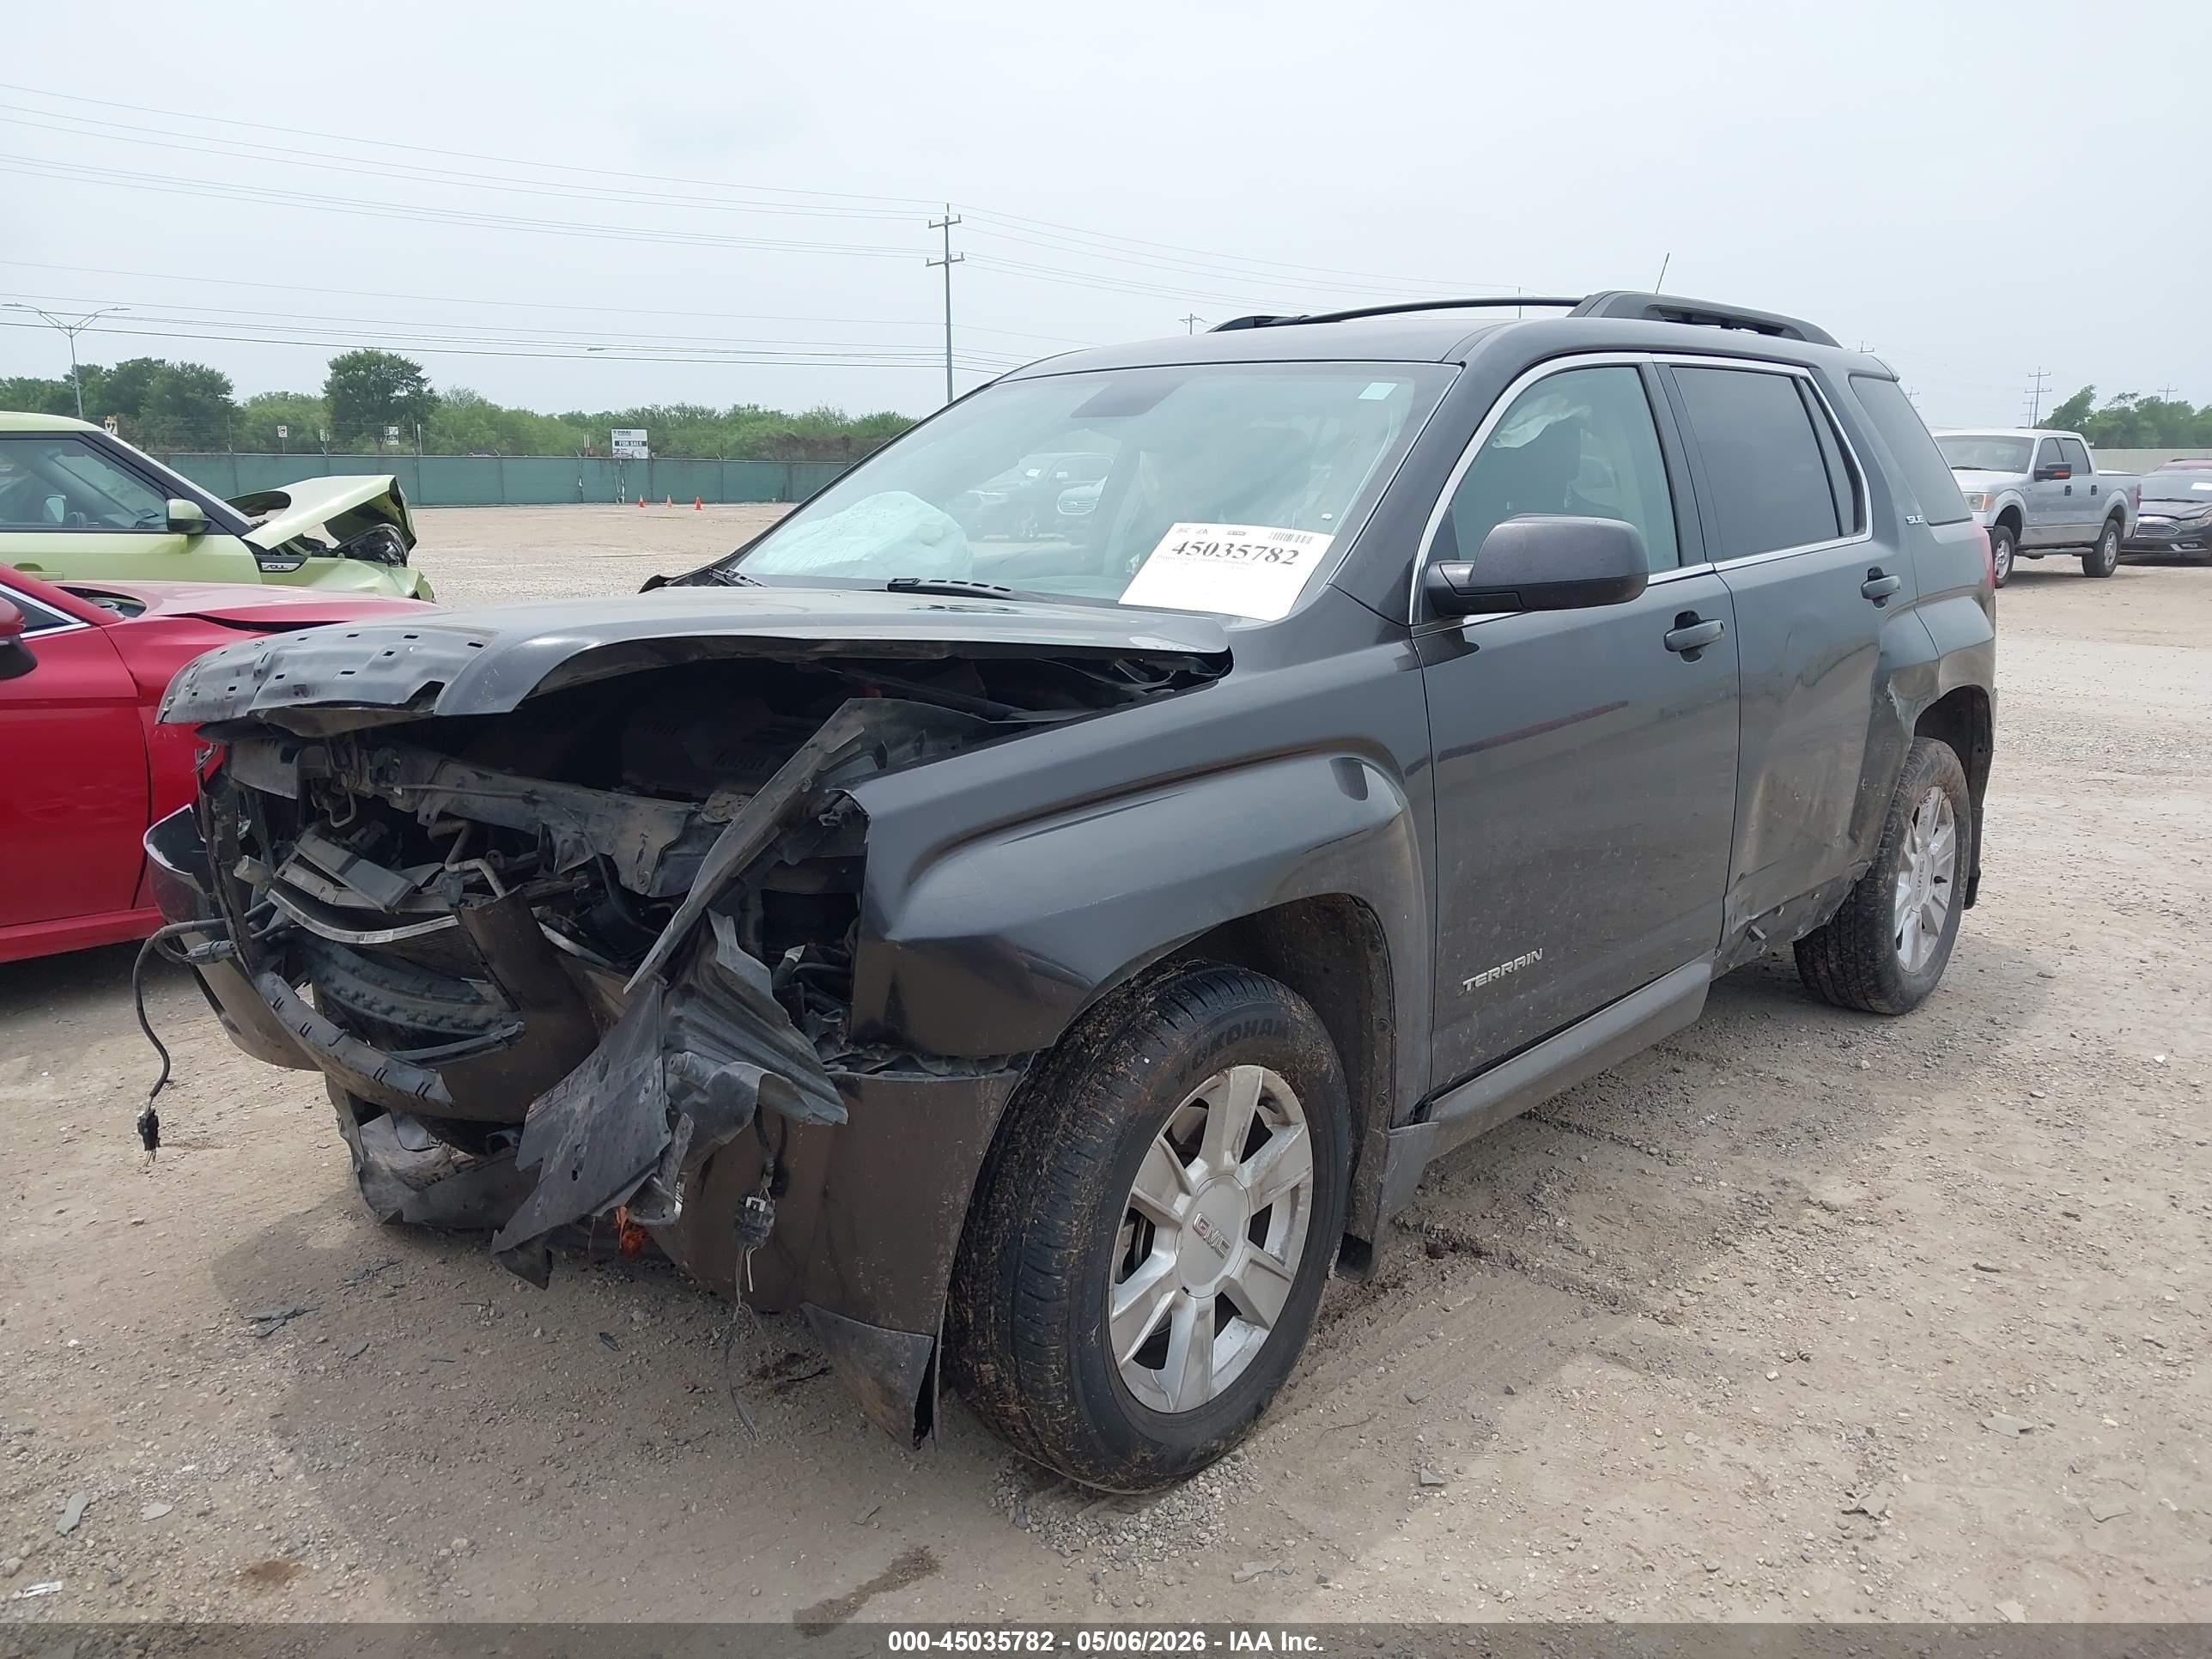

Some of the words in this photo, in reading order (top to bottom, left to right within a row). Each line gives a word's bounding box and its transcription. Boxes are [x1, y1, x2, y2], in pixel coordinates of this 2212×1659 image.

[1905, 514, 1923, 525] SLE
[1171, 540, 1299, 565] 45035782
[1462, 948, 1543, 991] TERRAIN
[1192, 1212, 1231, 1258] GMC
